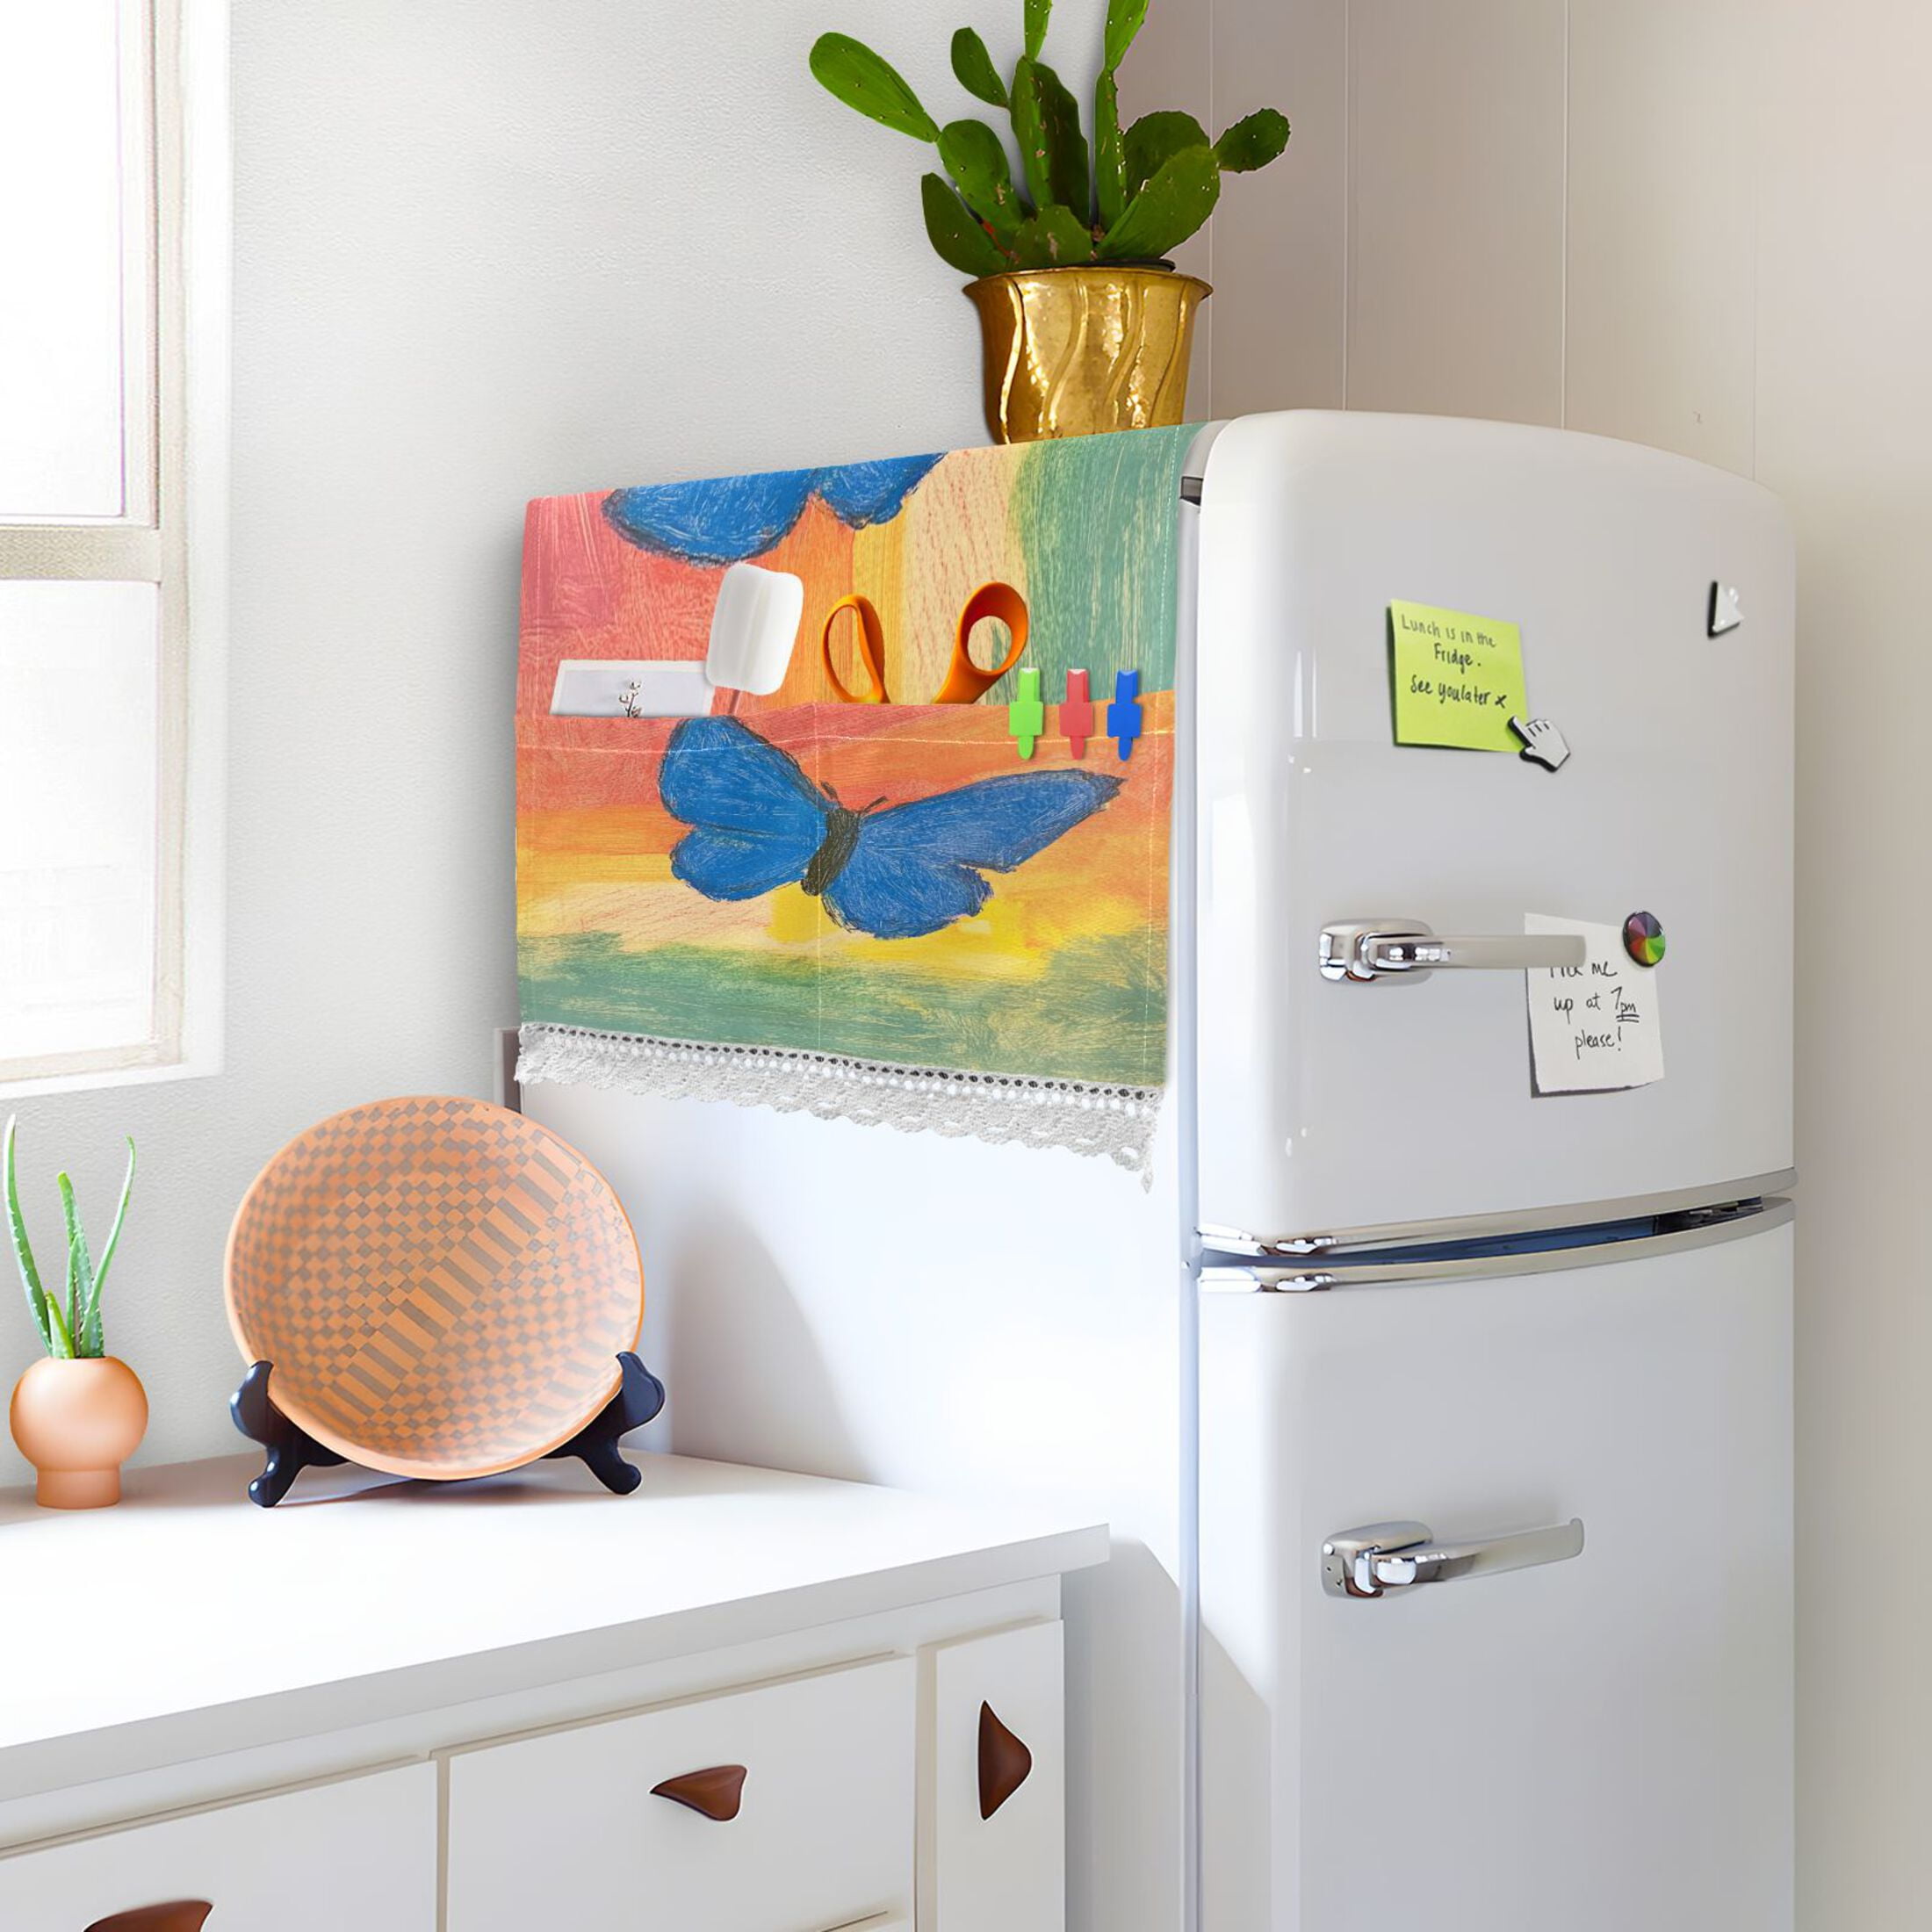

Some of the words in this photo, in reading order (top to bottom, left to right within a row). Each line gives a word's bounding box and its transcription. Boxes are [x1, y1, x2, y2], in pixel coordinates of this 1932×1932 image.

[1402, 614, 1440, 638] Lunch
[1445, 627, 1456, 640] is
[1460, 631, 1474, 644] in
[1477, 632, 1496, 647] the
[1410, 674, 1433, 694] See
[1554, 997, 1574, 1024] up
[1586, 992, 1601, 1011] at
[1575, 1026, 1622, 1060] please!
